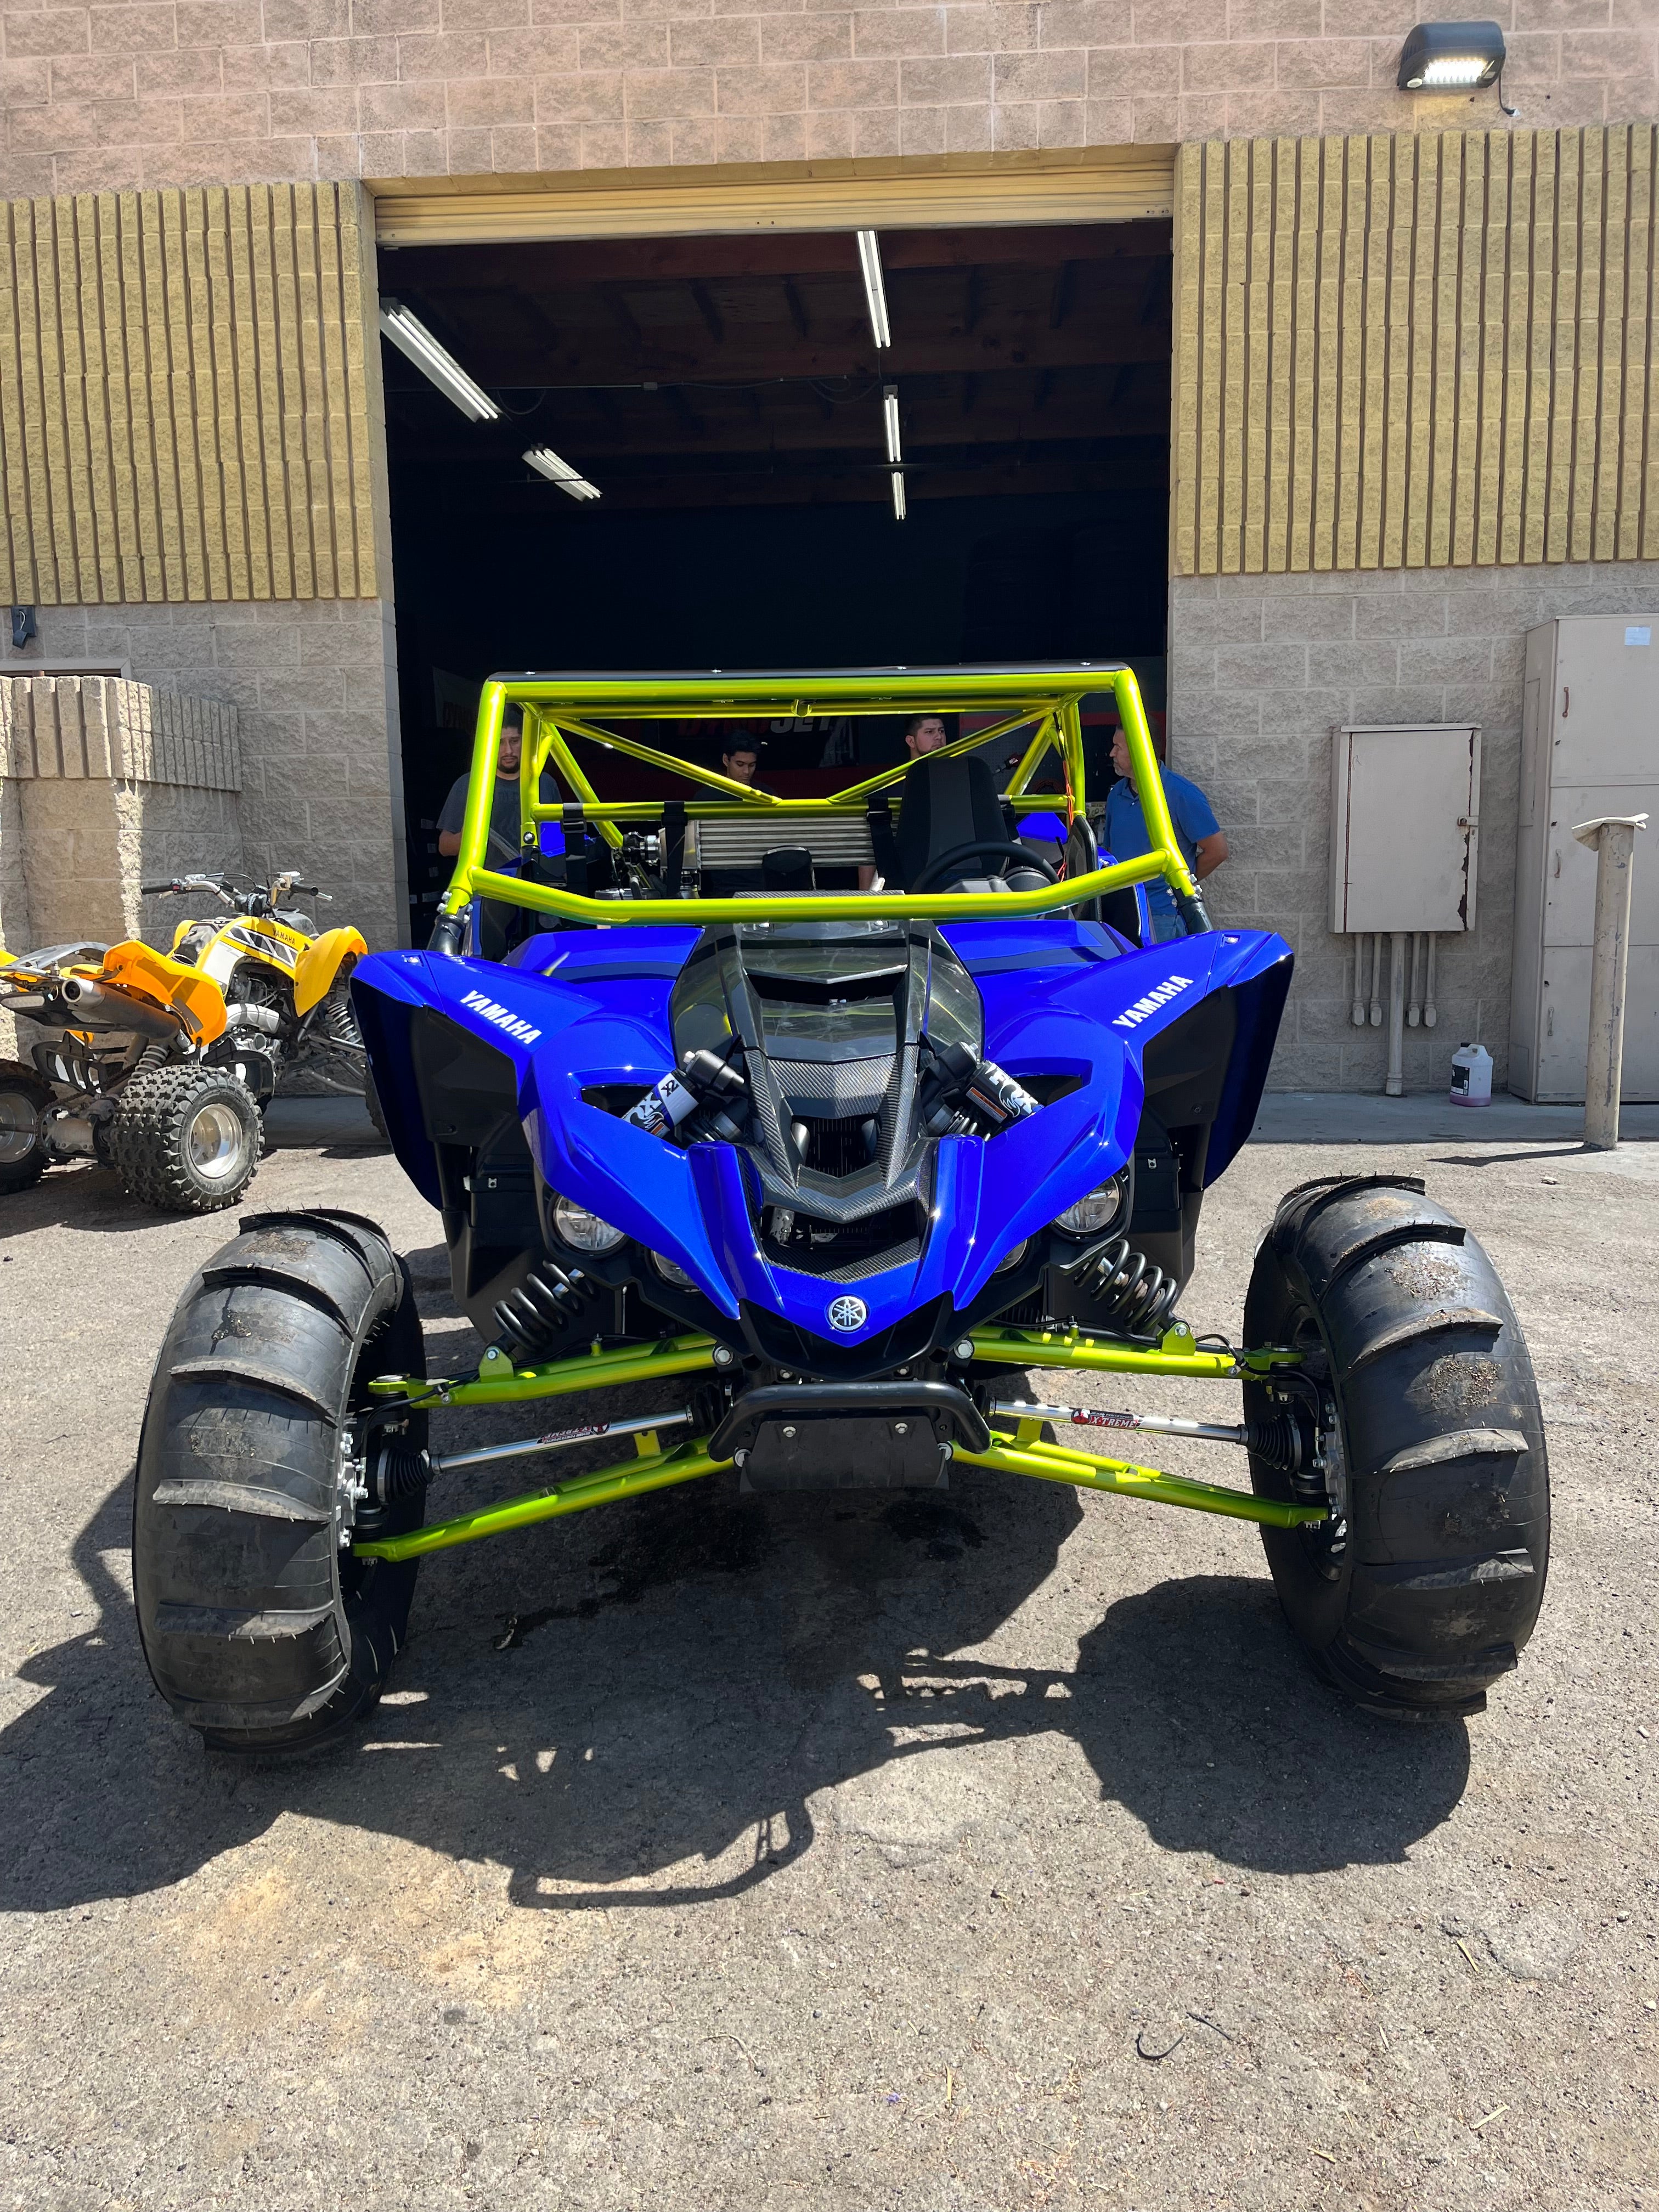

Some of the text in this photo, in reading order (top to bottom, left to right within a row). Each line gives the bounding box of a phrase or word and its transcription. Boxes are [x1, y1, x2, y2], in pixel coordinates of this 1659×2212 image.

[272, 928, 295, 945] YAMAHA
[460, 990, 543, 1045] YAMAHA
[1111, 975, 1194, 1028] YAMAHA
[661, 1079, 680, 1097] X2
[989, 1066, 1039, 1118] FOX
[1092, 1417, 1135, 1427] X-TREME
